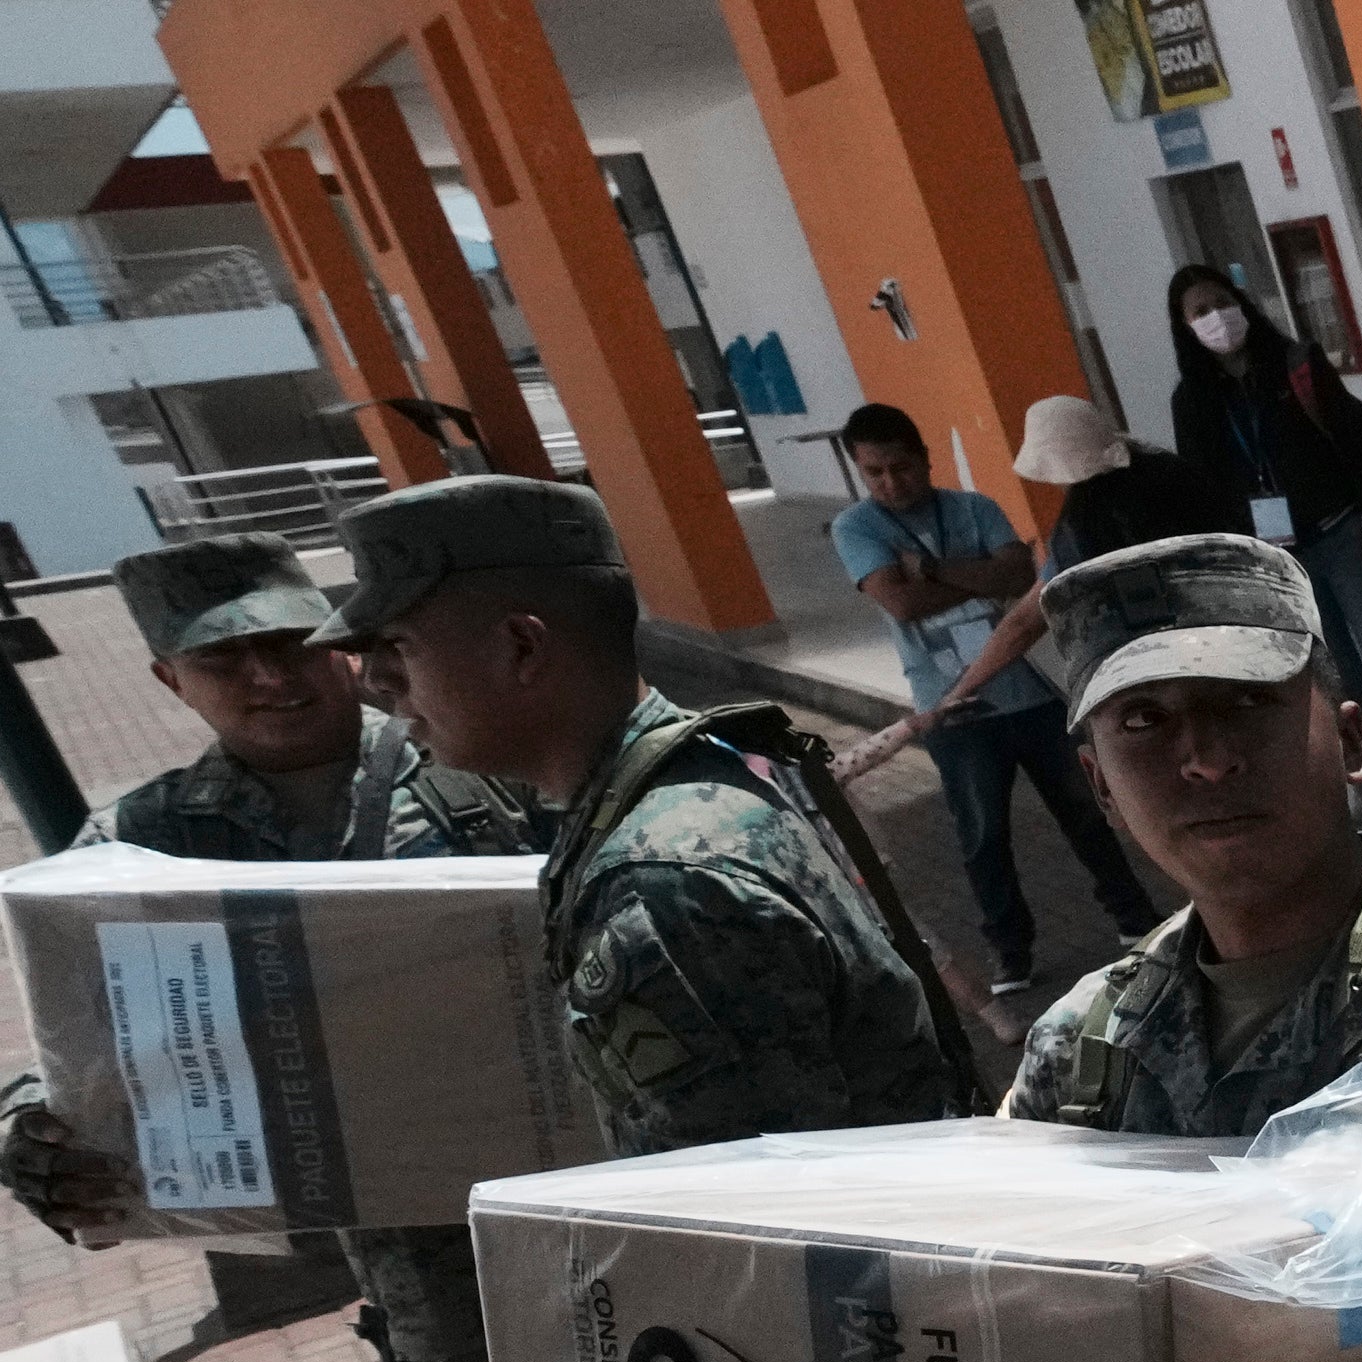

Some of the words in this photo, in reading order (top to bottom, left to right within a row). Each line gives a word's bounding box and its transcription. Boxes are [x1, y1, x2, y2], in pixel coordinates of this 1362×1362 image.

[189, 942, 210, 998] ELECTORAL
[251, 912, 306, 1074] ELECTORAL
[167, 977, 193, 1050] SEGURIDAD
[198, 1001, 218, 1045] PAQUETE
[180, 1054, 198, 1068] DE
[187, 1072, 209, 1108] SELLO
[219, 1098, 237, 1132] FUNDA
[280, 1077, 331, 1201] PAQUETE
